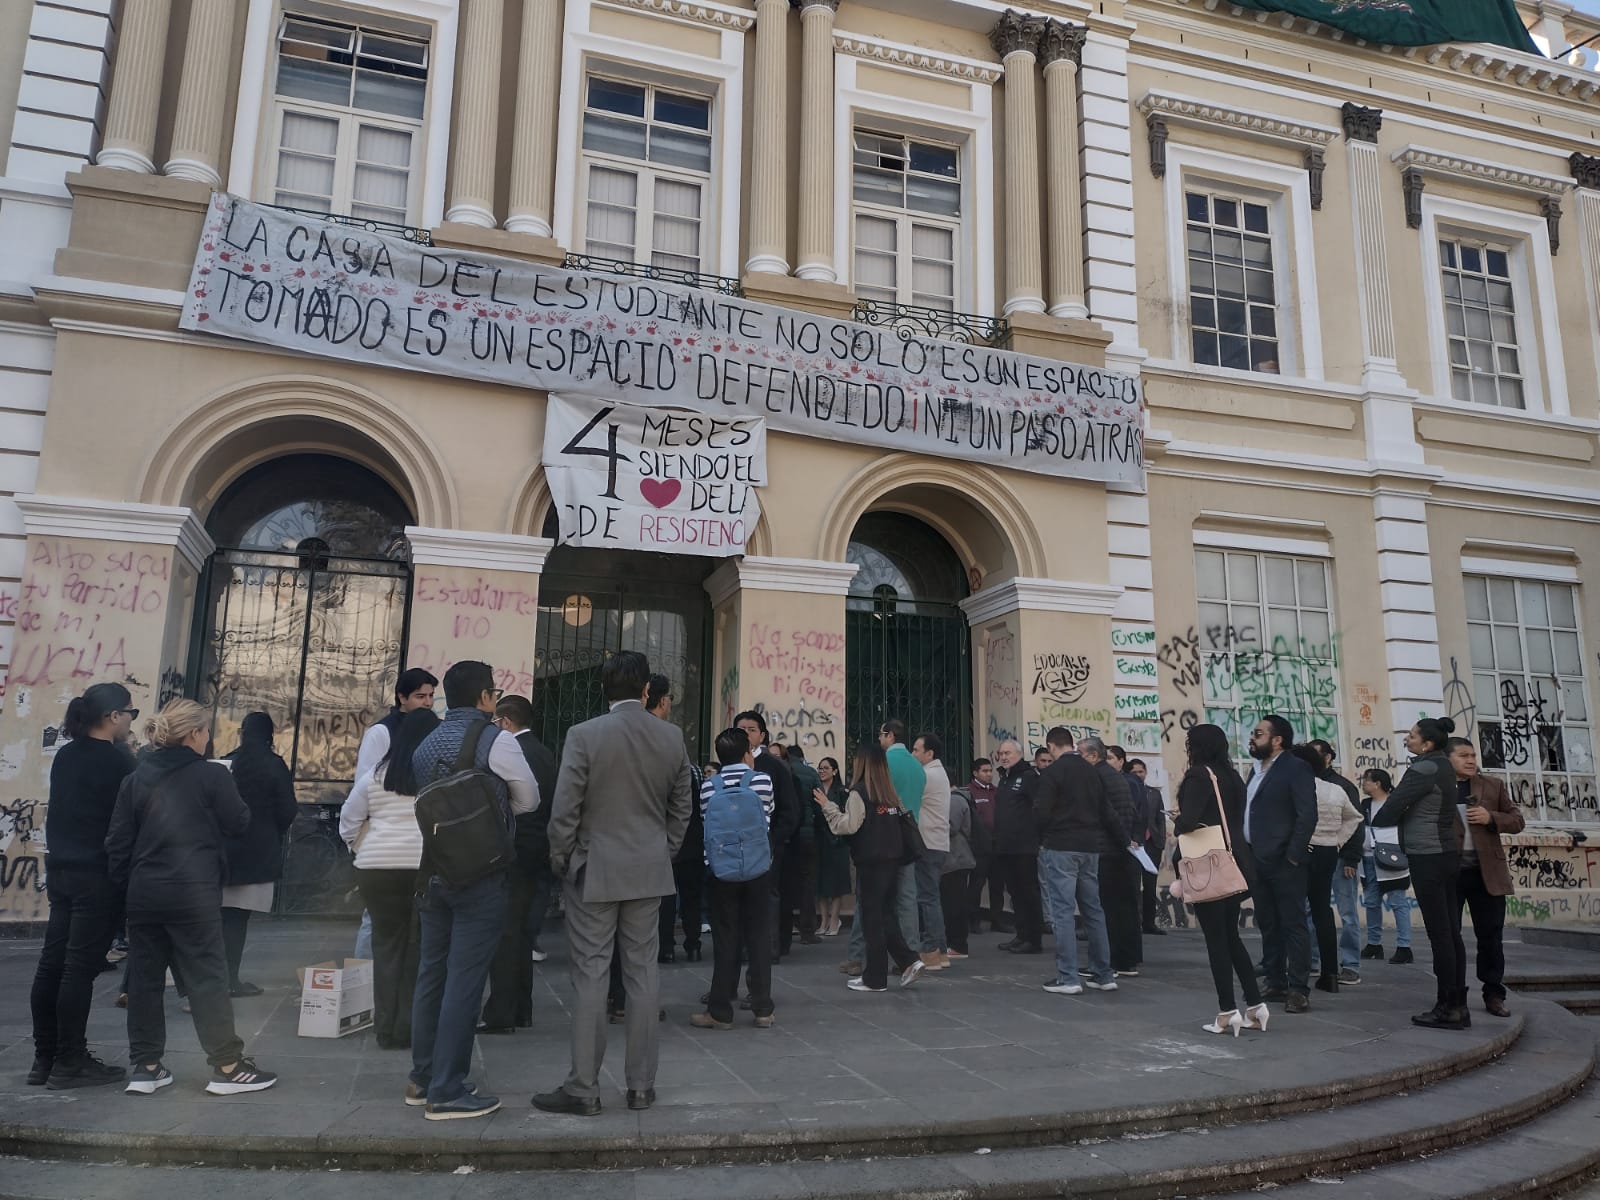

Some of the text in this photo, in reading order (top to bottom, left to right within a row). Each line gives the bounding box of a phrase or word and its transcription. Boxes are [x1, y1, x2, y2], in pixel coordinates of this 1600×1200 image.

[221, 200, 268, 256] LA
[286, 225, 395, 280] CASA
[419, 254, 517, 306] DEL
[533, 274, 763, 339] ESTUDIANTE
[776, 317, 820, 354] NO
[941, 345, 980, 383] ES
[985, 352, 1020, 389] UN
[1026, 363, 1138, 404] ESPACIO
[217, 267, 392, 350] TOMADO
[403, 306, 448, 356] ES
[471, 317, 515, 364] UN
[526, 327, 676, 391] ESPACIO
[697, 353, 905, 433] DEFENDIDO
[969, 402, 1003, 450] UN
[1010, 409, 1077, 459] PASO
[560, 406, 634, 502] 4
[639, 450, 761, 482] SIENDO EL
[641, 413, 751, 448] MESES
